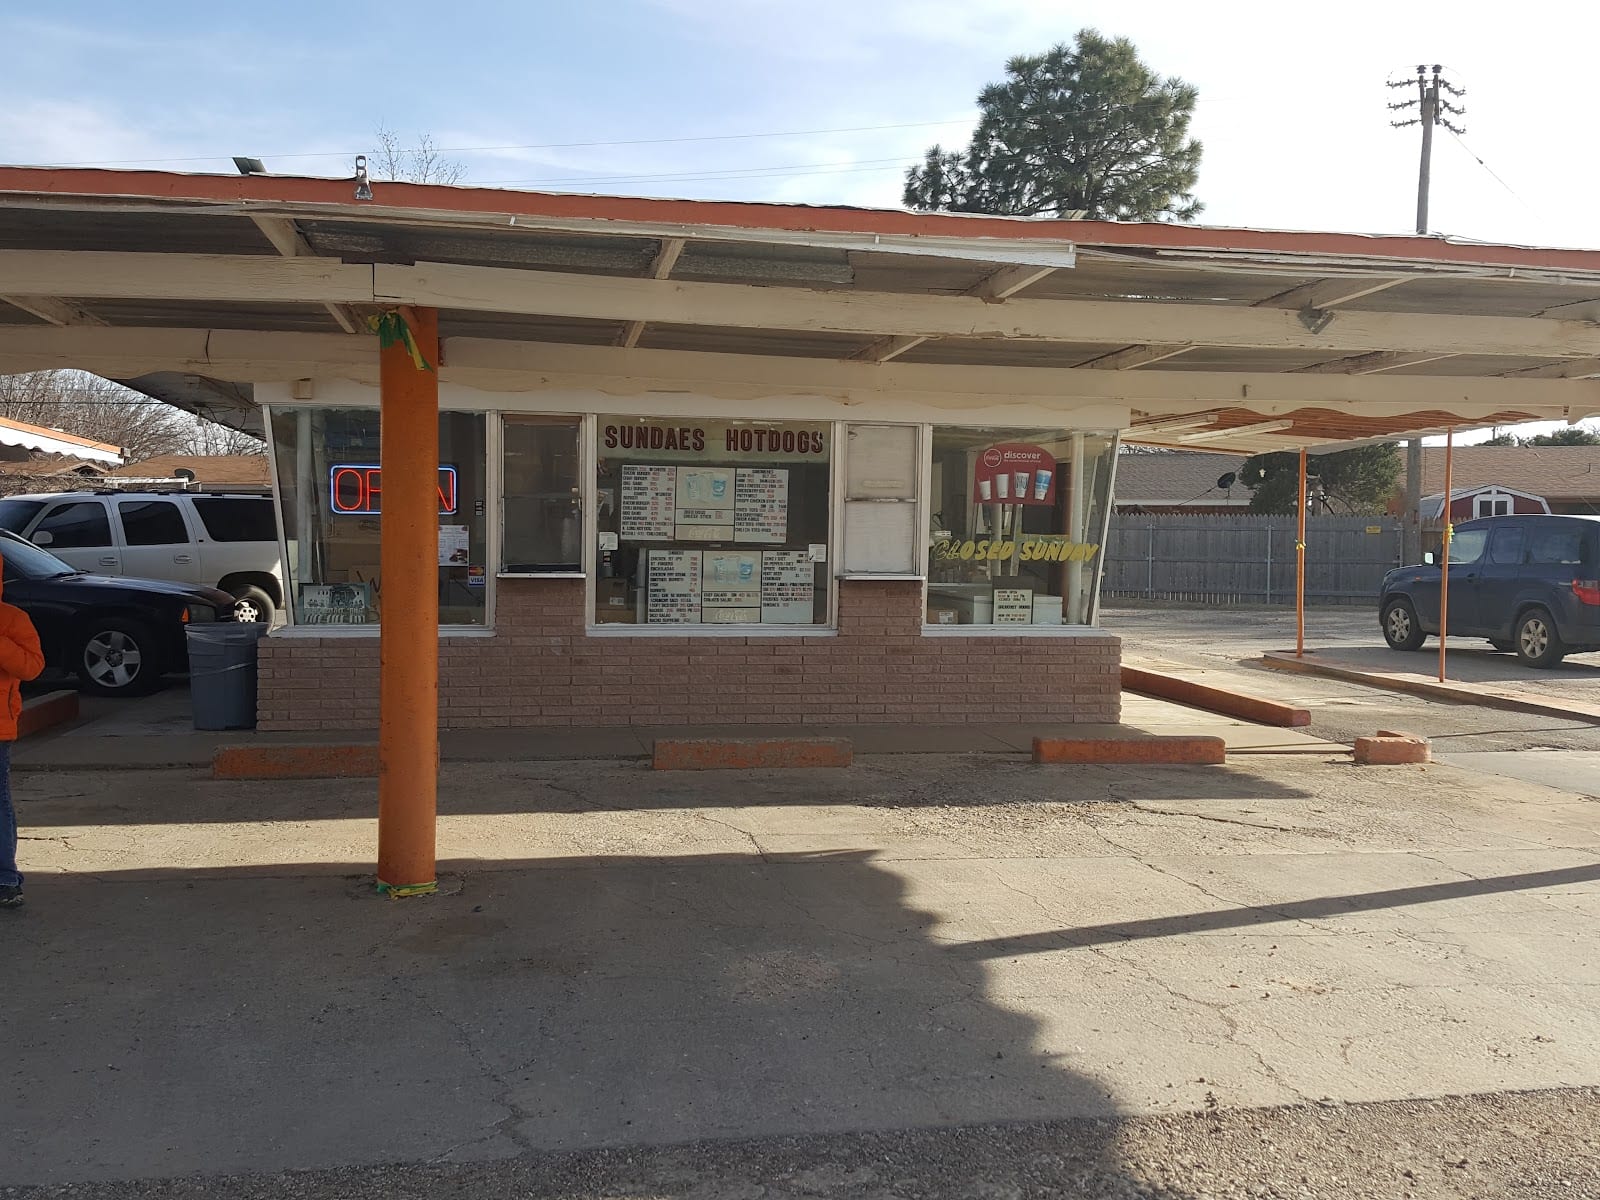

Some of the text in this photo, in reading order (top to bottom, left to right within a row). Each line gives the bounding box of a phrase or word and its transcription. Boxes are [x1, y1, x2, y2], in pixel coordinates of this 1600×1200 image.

[605, 425, 823, 453] SUNDAES HOTDOGS
[1004, 450, 1041, 459] discover
[335, 468, 453, 511] OPN
[933, 540, 1099, 562] CLOSED SUNDAY
